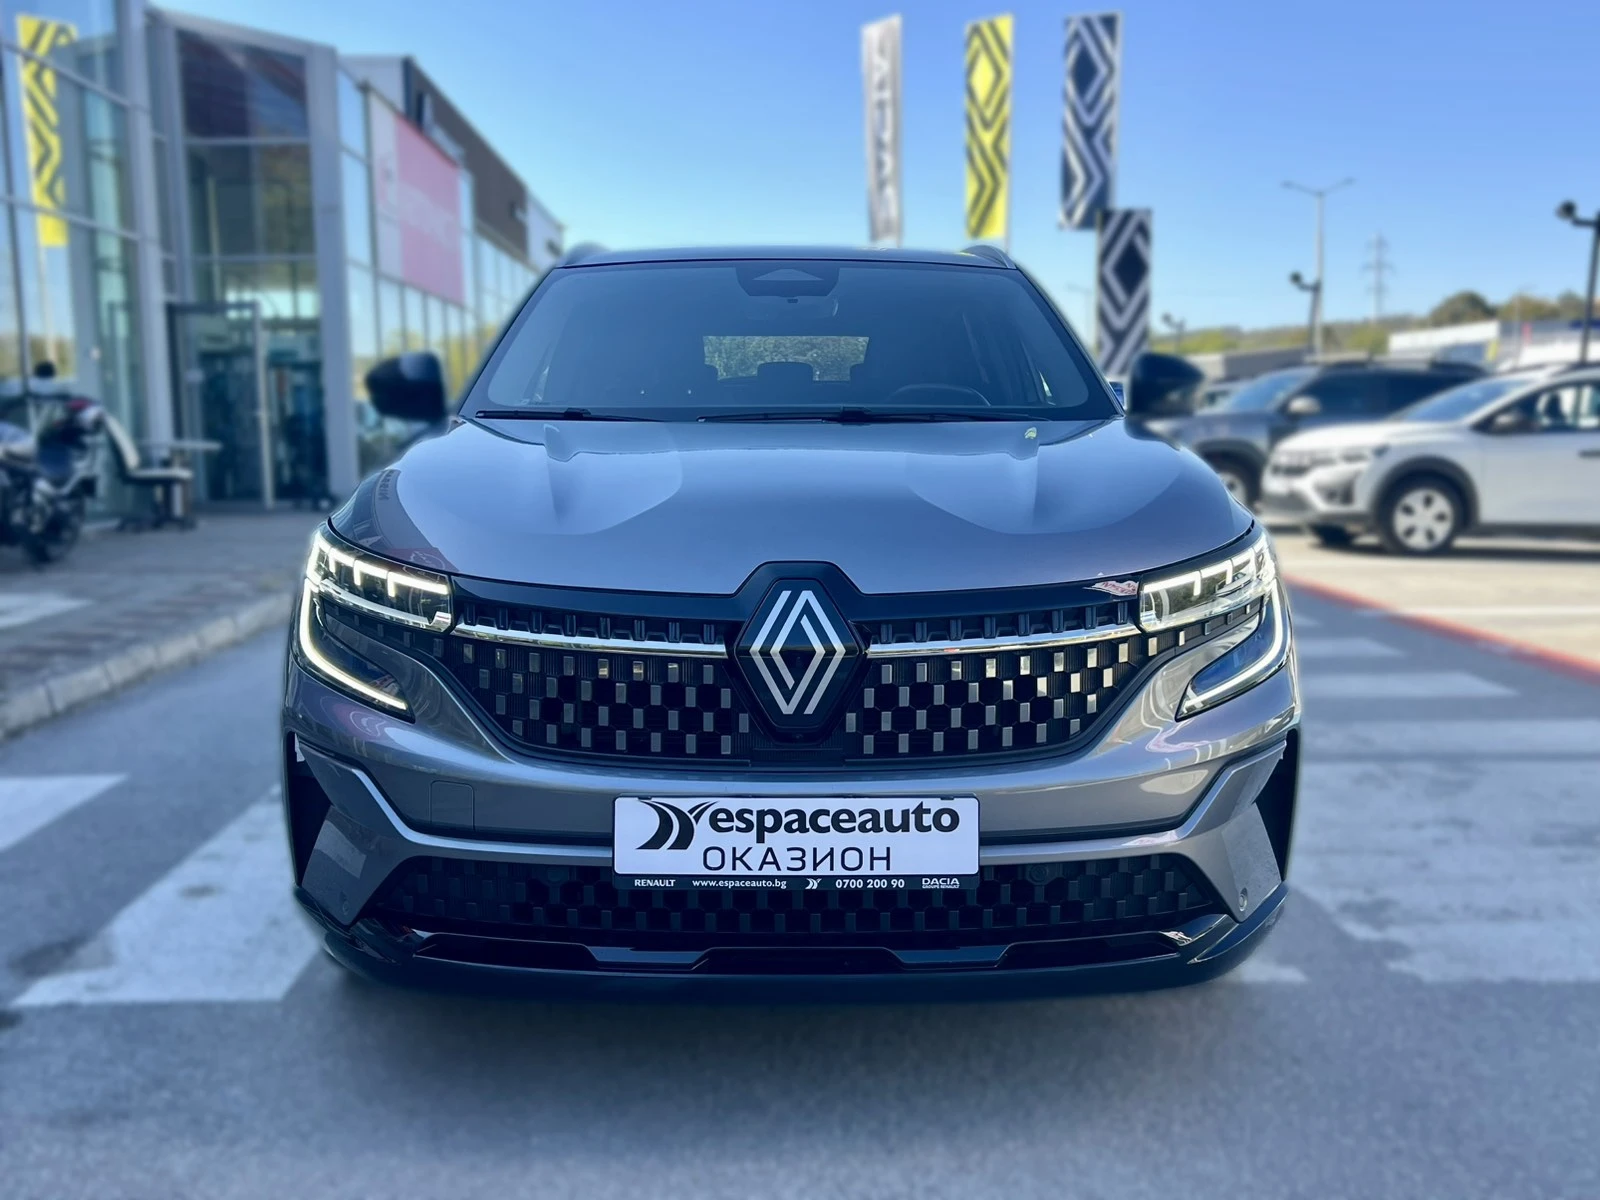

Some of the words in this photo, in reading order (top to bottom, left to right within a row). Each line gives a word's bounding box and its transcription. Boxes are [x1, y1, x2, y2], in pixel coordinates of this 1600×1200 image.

[708, 801, 960, 844] espaceauto
[702, 846, 891, 872] ОКАЗИОН
[634, 878, 676, 887] RENAULT
[692, 878, 787, 889] www.espaceauto.bg
[835, 878, 864, 889] 0700
[866, 878, 888, 889] 200
[891, 878, 905, 889] 90
[921, 877, 960, 885] DACIA
